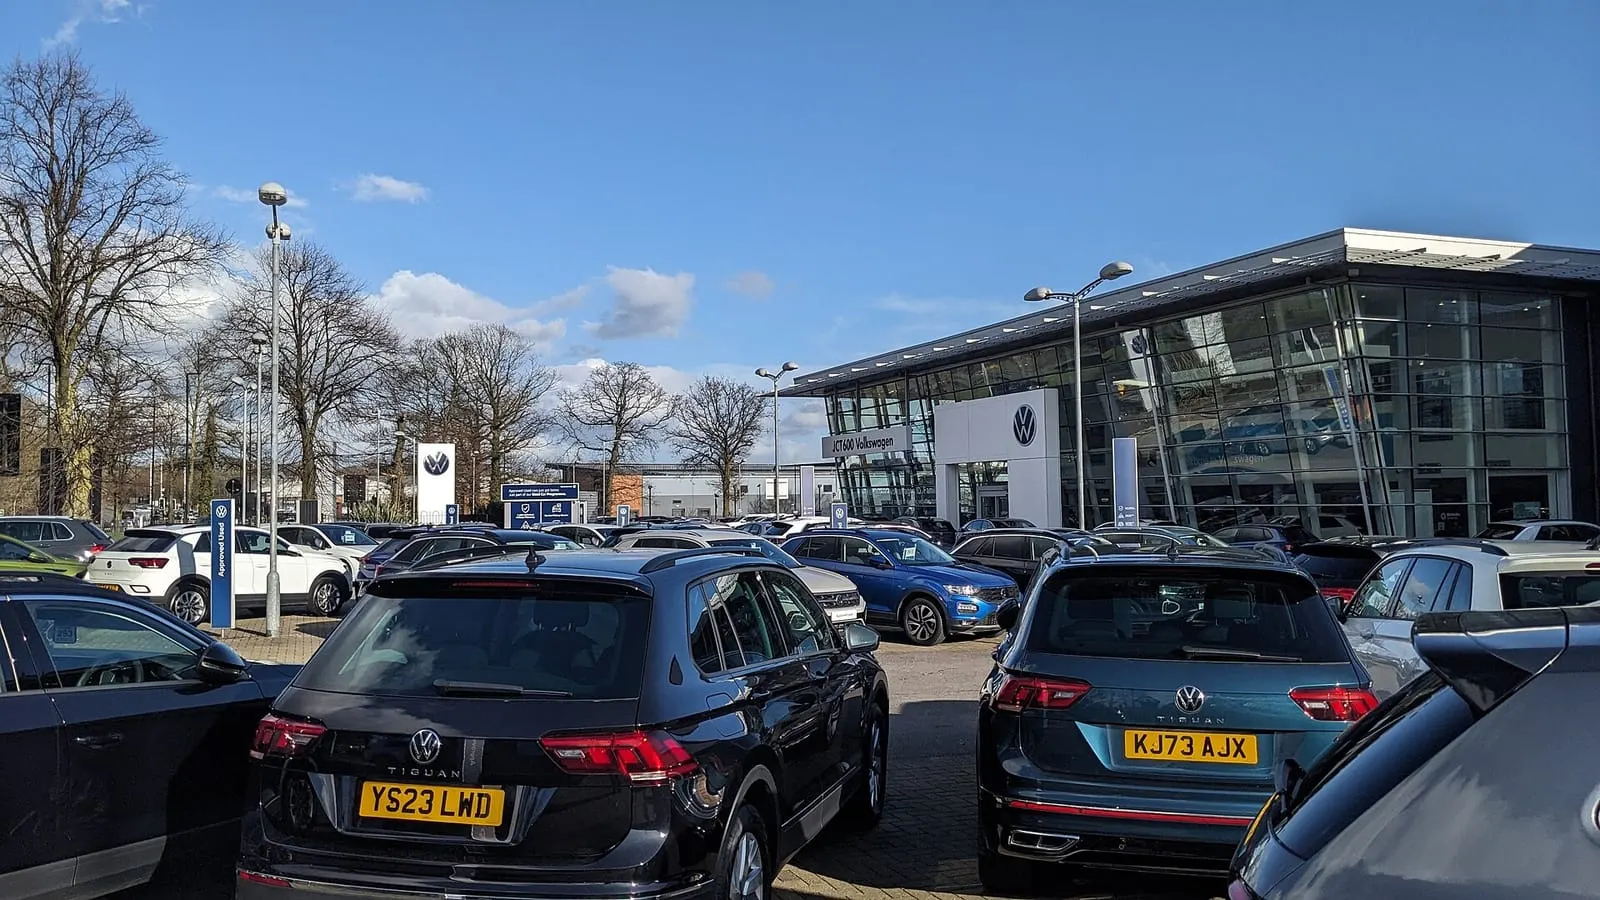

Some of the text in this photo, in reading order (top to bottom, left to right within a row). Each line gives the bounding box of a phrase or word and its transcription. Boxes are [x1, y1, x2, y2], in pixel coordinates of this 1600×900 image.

[832, 436, 894, 453] JCT600 Volkswagen
[218, 541, 226, 577] Approved
[1133, 733, 1247, 759] KJ73 AJX
[387, 766, 460, 778] TIGUAN
[372, 785, 492, 819] YS23 LWD
